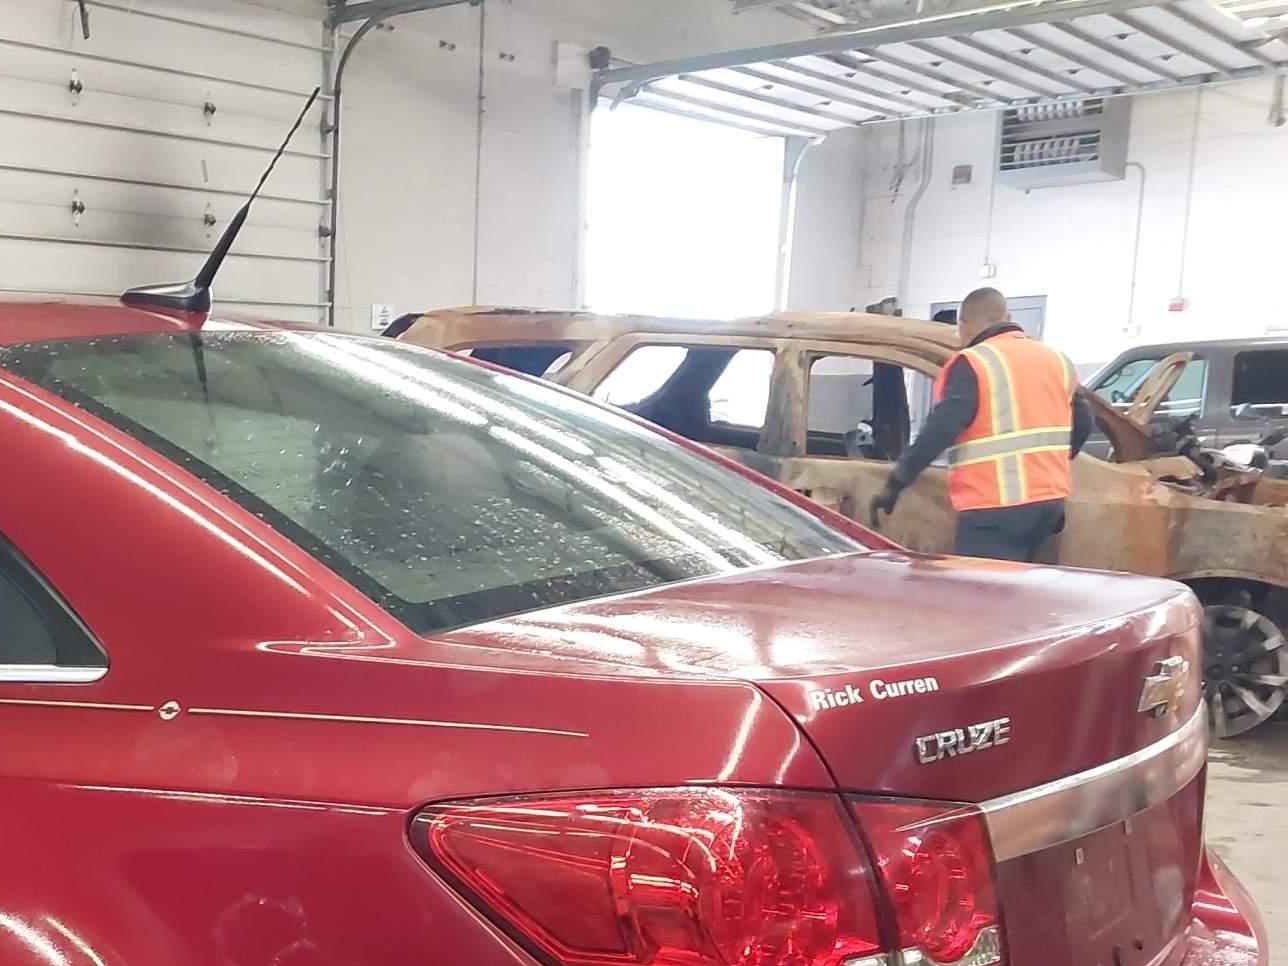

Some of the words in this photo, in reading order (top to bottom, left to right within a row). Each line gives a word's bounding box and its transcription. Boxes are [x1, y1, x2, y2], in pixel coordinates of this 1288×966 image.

[809, 684, 864, 711] Rick
[869, 676, 939, 700] Curren
[916, 716, 1011, 764] CRUZE
